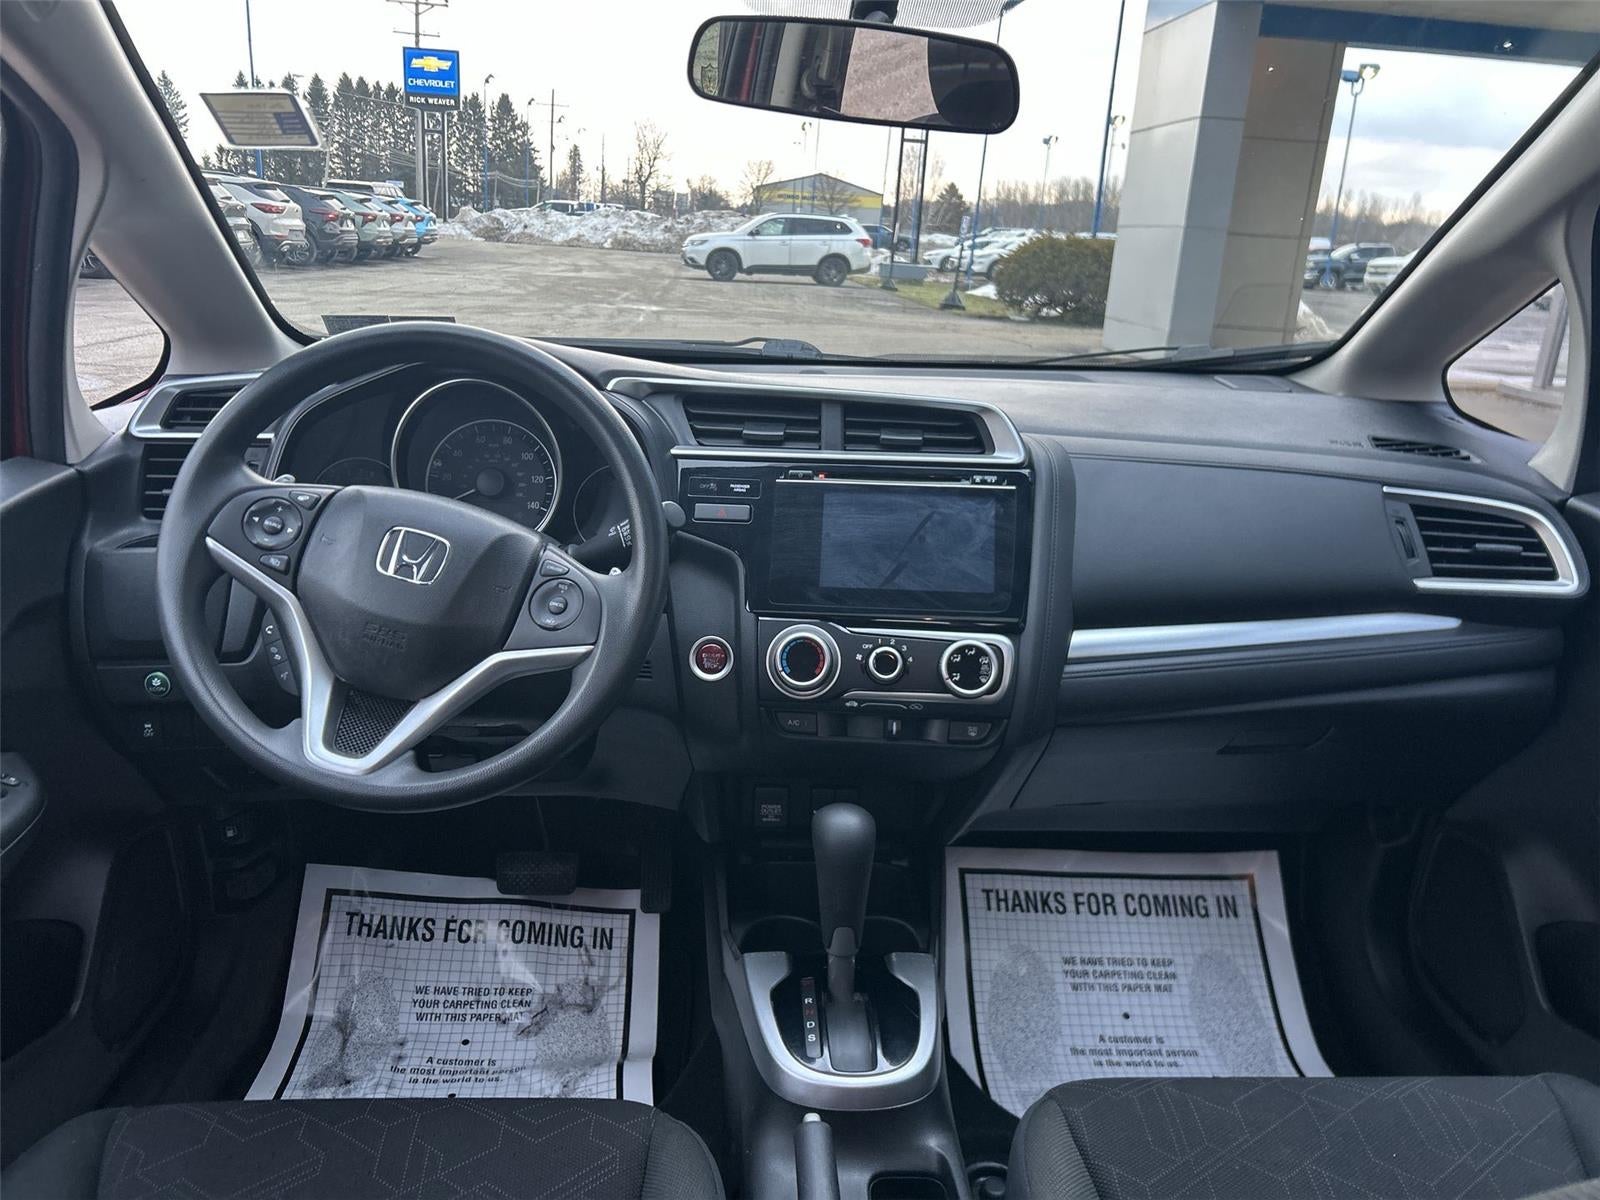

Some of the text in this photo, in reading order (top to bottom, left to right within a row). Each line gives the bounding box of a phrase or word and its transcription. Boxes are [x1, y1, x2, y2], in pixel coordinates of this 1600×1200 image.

[408, 78, 455, 88] CHEVROLET
[410, 96, 455, 106] RICK WEAVER
[521, 452, 534, 460] 100
[531, 475, 544, 484] 120
[527, 501, 540, 510] 140
[787, 719, 800, 727] A/C
[981, 888, 1239, 919] THANKS FOR COMING IN
[346, 911, 436, 942] THANKS
[592, 927, 614, 950] IN
[415, 985, 533, 997] WE HAVE TRIED TO KEEP
[1071, 983, 1095, 992] WITH
[1098, 983, 1119, 992] THIS
[1121, 983, 1151, 993] PAPER
[412, 999, 531, 1009] YOUR CARPETING CLEAN
[416, 1012, 442, 1022] WITH
[445, 1012, 467, 1022] THIS
[469, 1012, 500, 1022] PAPER
[807, 1034, 816, 1042] S
[1098, 1034, 1106, 1043] A
[426, 1056, 496, 1067] A customer is
[390, 1065, 406, 1074] the
[409, 1067, 436, 1075] most
[439, 1067, 489, 1076] important
[408, 1076, 418, 1084] in
[422, 1076, 439, 1084] the
[442, 1076, 471, 1084] world
[475, 1076, 484, 1084] to
